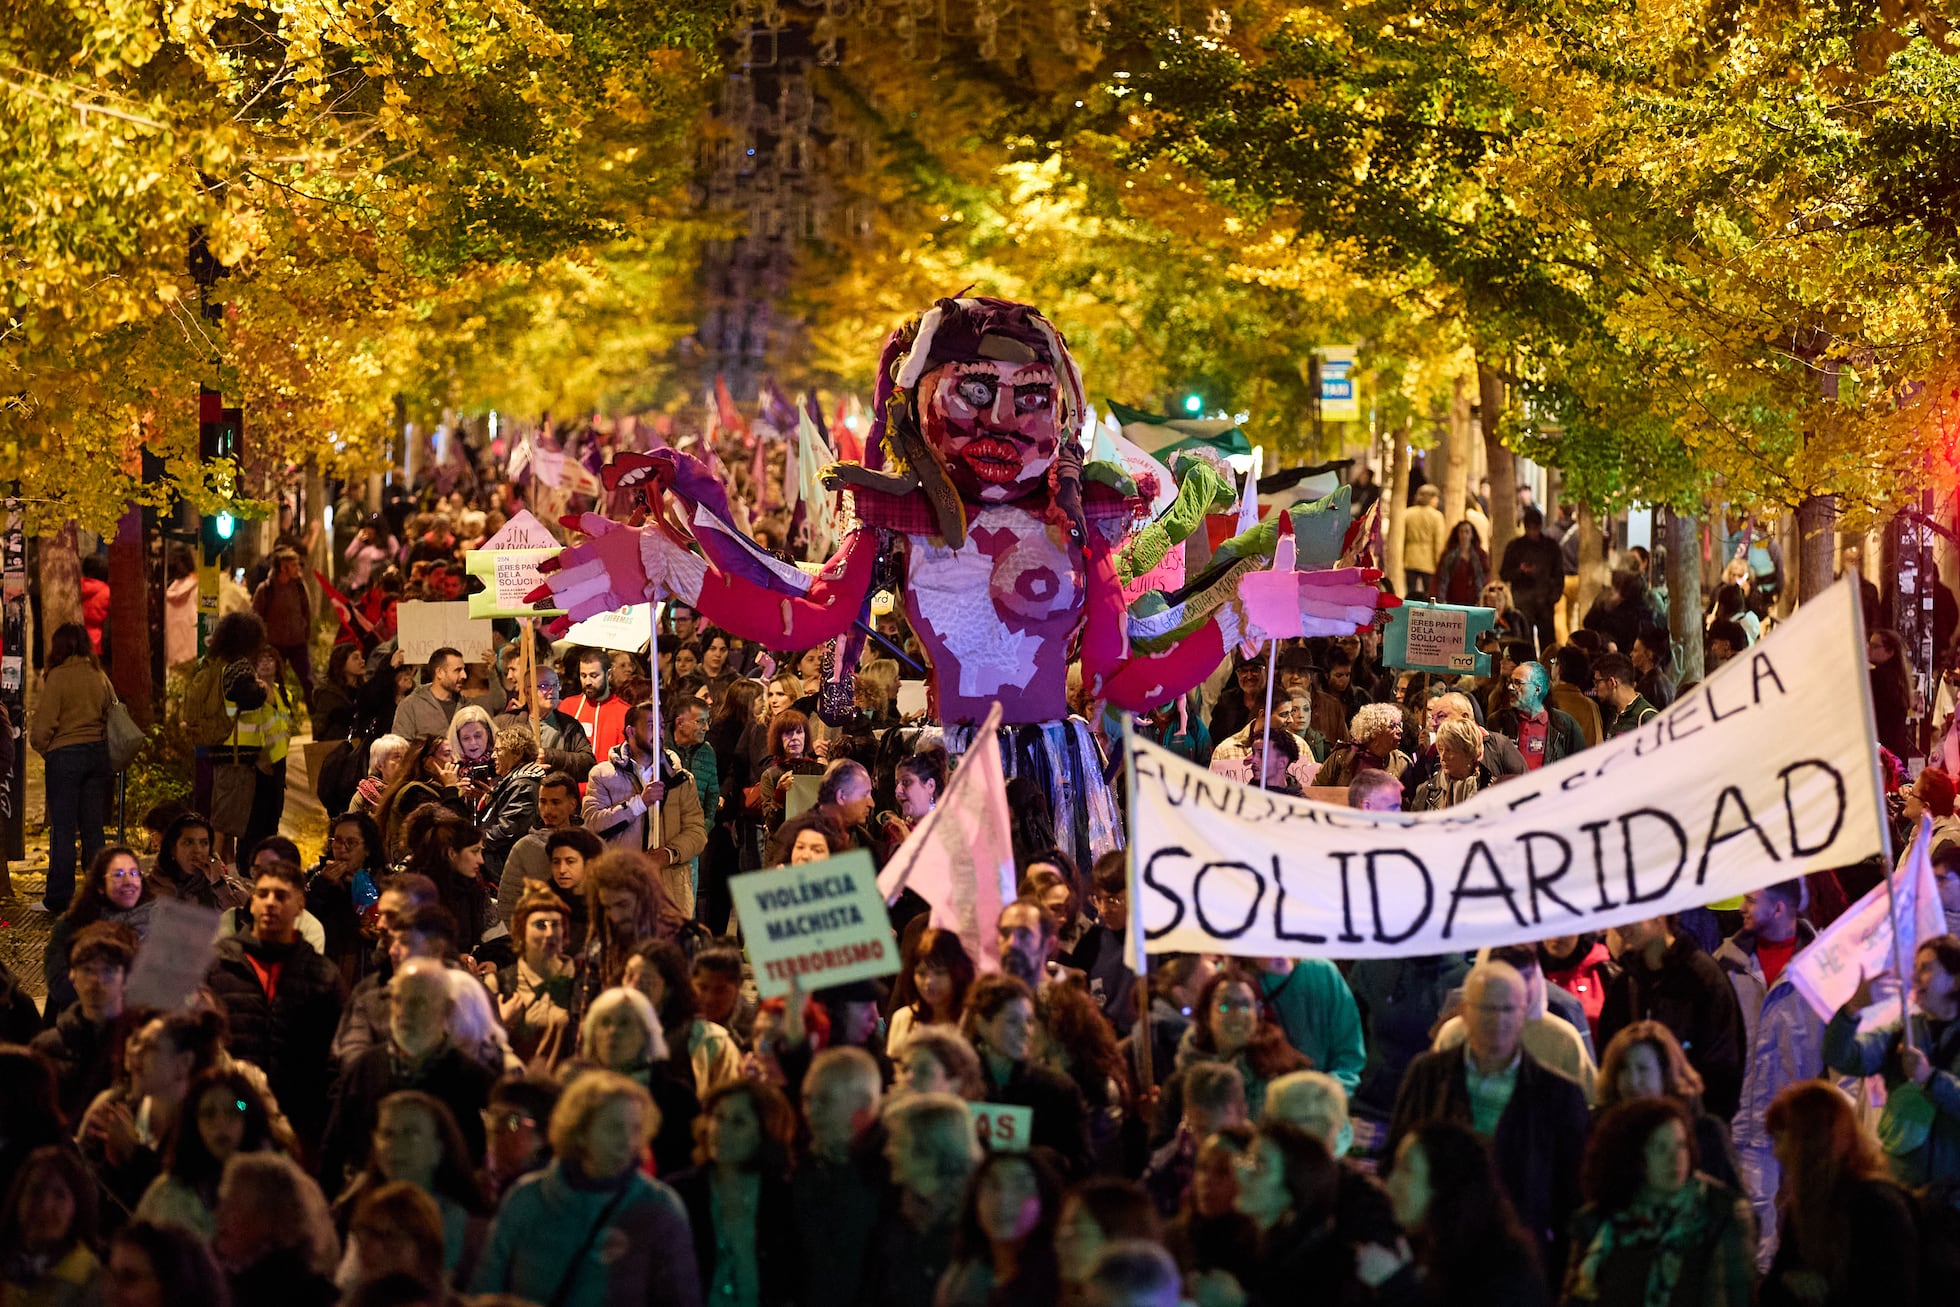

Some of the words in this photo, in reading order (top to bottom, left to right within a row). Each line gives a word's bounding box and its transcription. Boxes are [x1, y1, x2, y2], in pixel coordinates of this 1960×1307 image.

[498, 571, 509, 579] DE
[1435, 621, 1462, 630] PARTE
[1143, 758, 1847, 945] SOLIDARIDAD
[766, 903, 864, 943] MACHISTA
[764, 938, 885, 982] TERRORISMO
